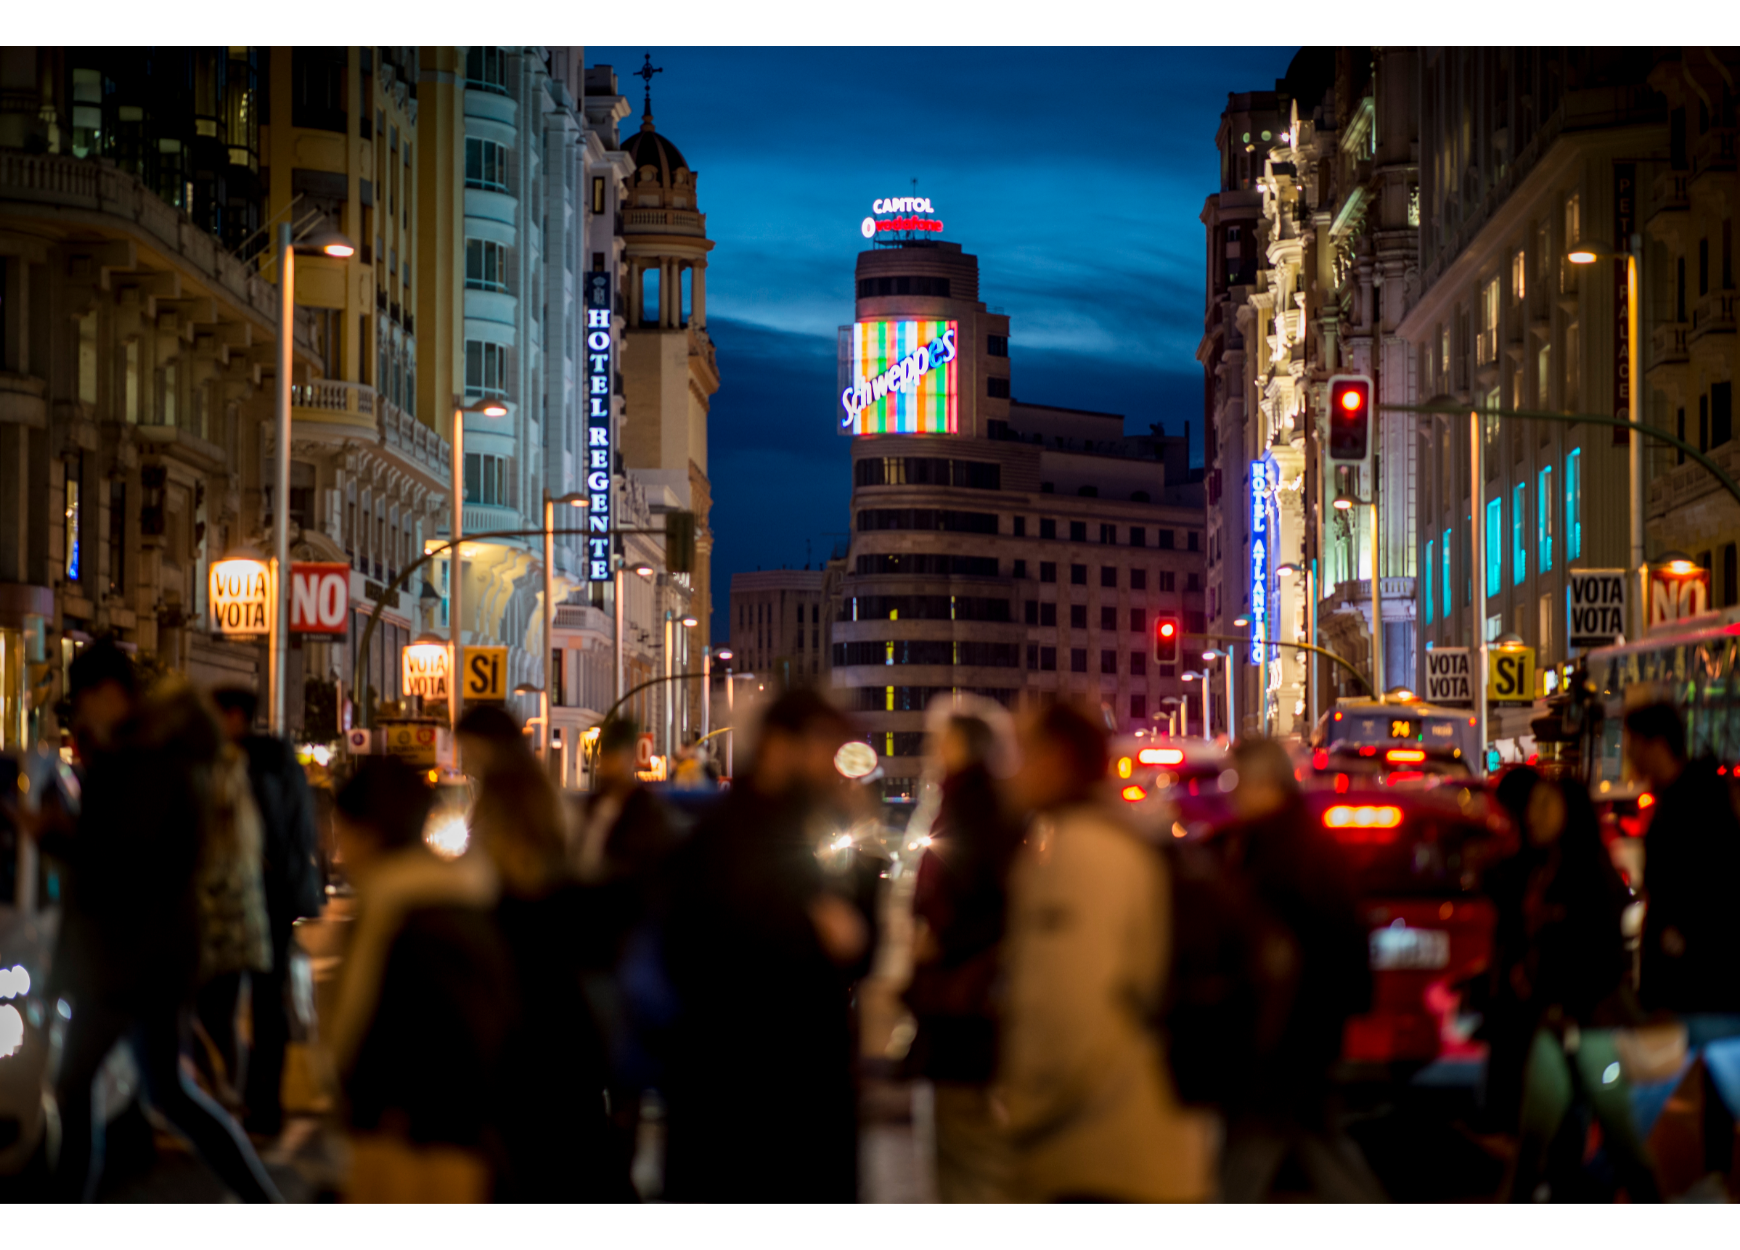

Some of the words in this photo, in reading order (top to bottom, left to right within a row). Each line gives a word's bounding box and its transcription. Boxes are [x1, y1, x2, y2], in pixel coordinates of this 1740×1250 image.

[873, 198, 934, 214] CAPITOL
[875, 215, 944, 232] vodafone
[1618, 285, 1630, 400] PALACE
[588, 309, 611, 418] HOTEL
[841, 328, 956, 427] Schweppes
[588, 427, 610, 580] REGENTE
[1252, 463, 1265, 533] HOTEL
[215, 572, 267, 598] VOTA
[291, 573, 348, 627] NO
[1571, 576, 1624, 604] VOTA
[214, 601, 266, 628] VOTA
[1652, 578, 1708, 628] NO
[1571, 607, 1624, 634] VOTA
[470, 653, 500, 694] SÍ
[1429, 654, 1470, 675] VOTA
[1496, 656, 1526, 695] SÍ
[408, 676, 446, 696] VOTA
[1429, 676, 1470, 698] VOTA
